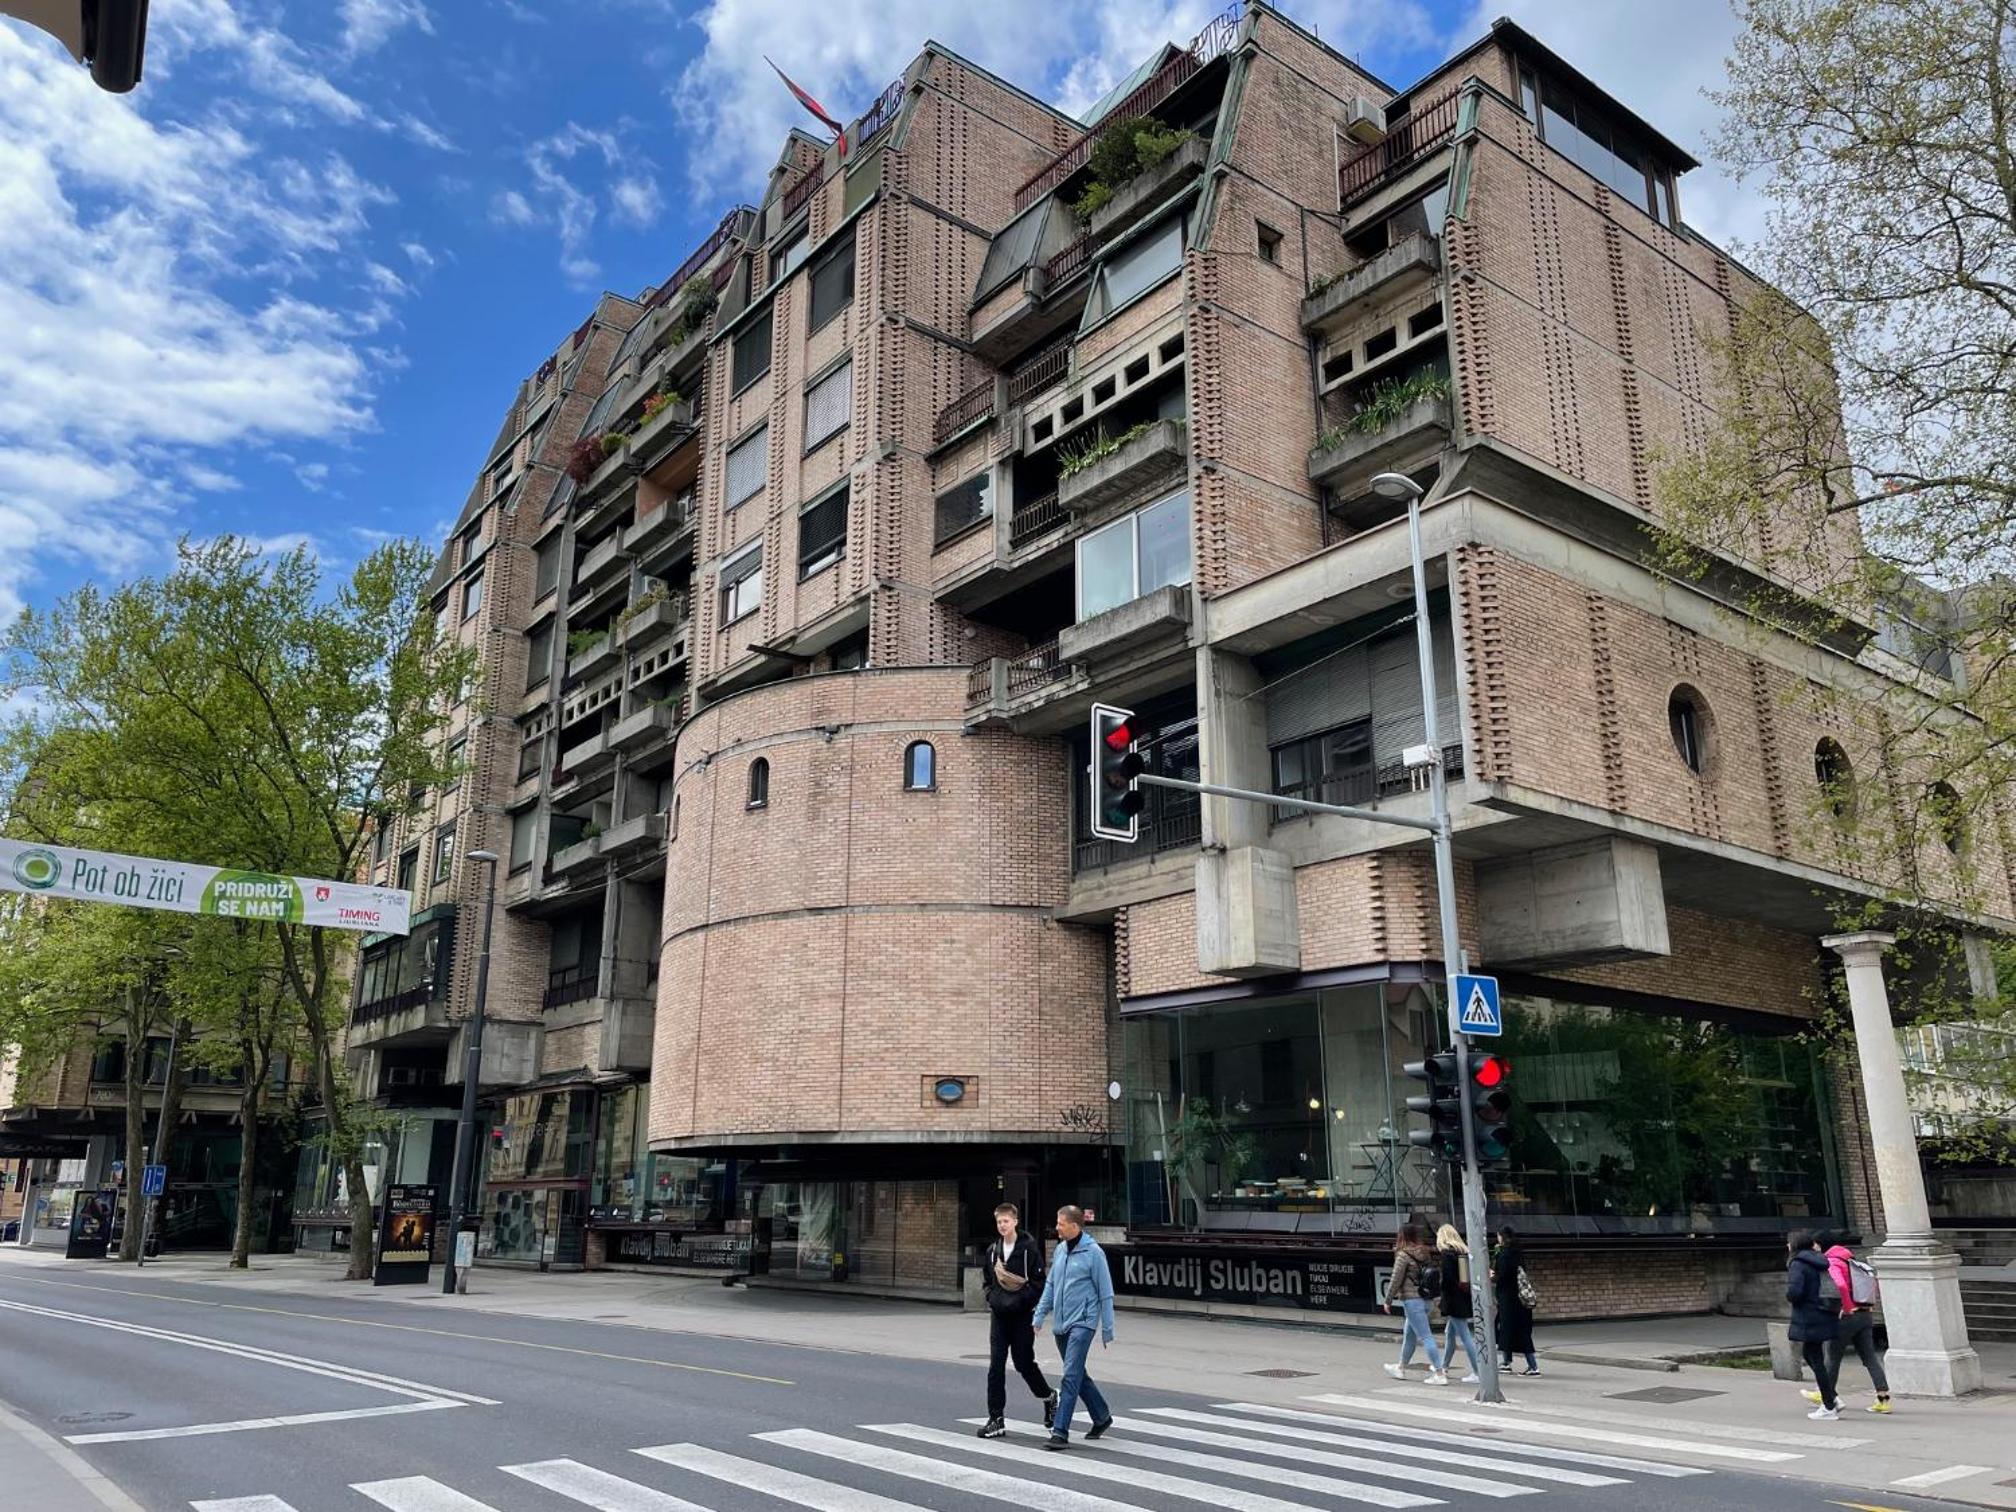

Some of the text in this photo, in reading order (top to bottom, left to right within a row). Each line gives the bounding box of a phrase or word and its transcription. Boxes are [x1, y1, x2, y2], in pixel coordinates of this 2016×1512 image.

[72, 858, 185, 903] Pot ob žici
[214, 881, 294, 899] PRIDRUŽI
[218, 900, 284, 917] SE NAM
[339, 908, 380, 922] TIMING
[1124, 1256, 1302, 1296] Klavdij Sluban
